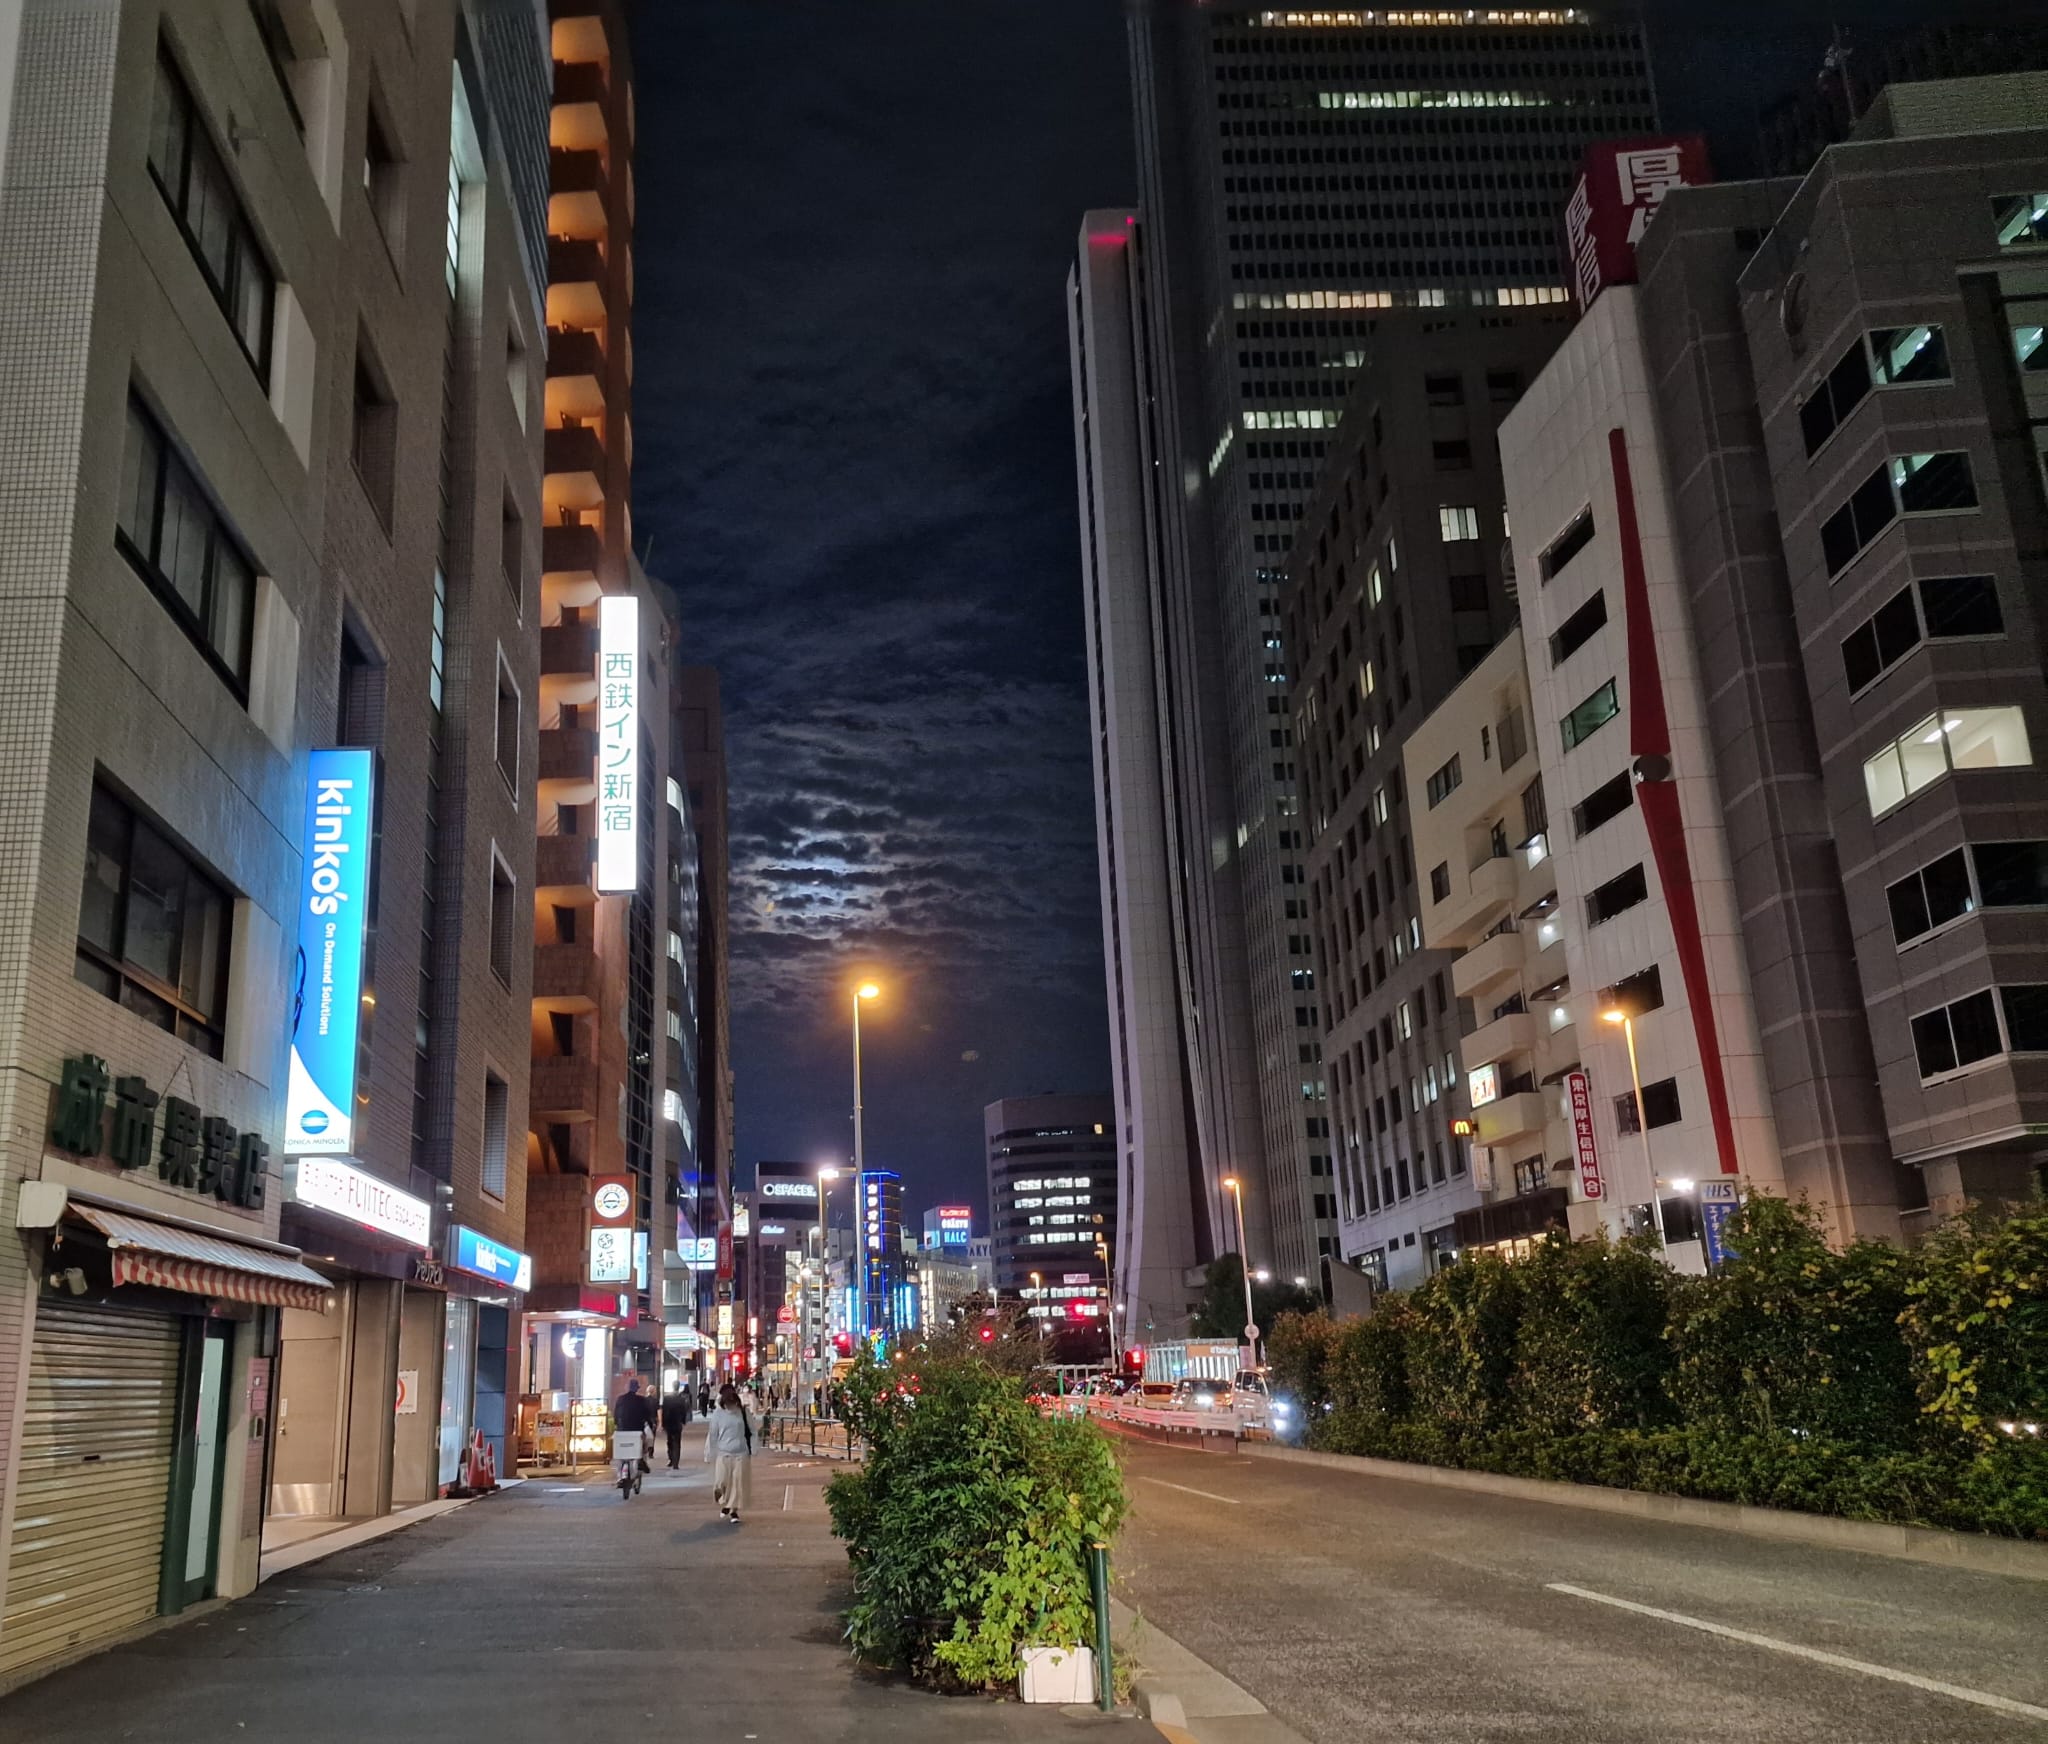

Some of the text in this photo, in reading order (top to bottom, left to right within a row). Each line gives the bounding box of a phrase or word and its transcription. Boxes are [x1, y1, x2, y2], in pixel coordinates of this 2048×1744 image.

[604, 653, 633, 831] 西鉄イン新宿
[309, 779, 353, 916] kinko's
[318, 921, 337, 1036] On Demand Solutions
[1571, 1079, 1599, 1193] 東京厚生信用組合
[349, 1175, 391, 1221] FUJITEC
[944, 1231, 967, 1243] HALC
